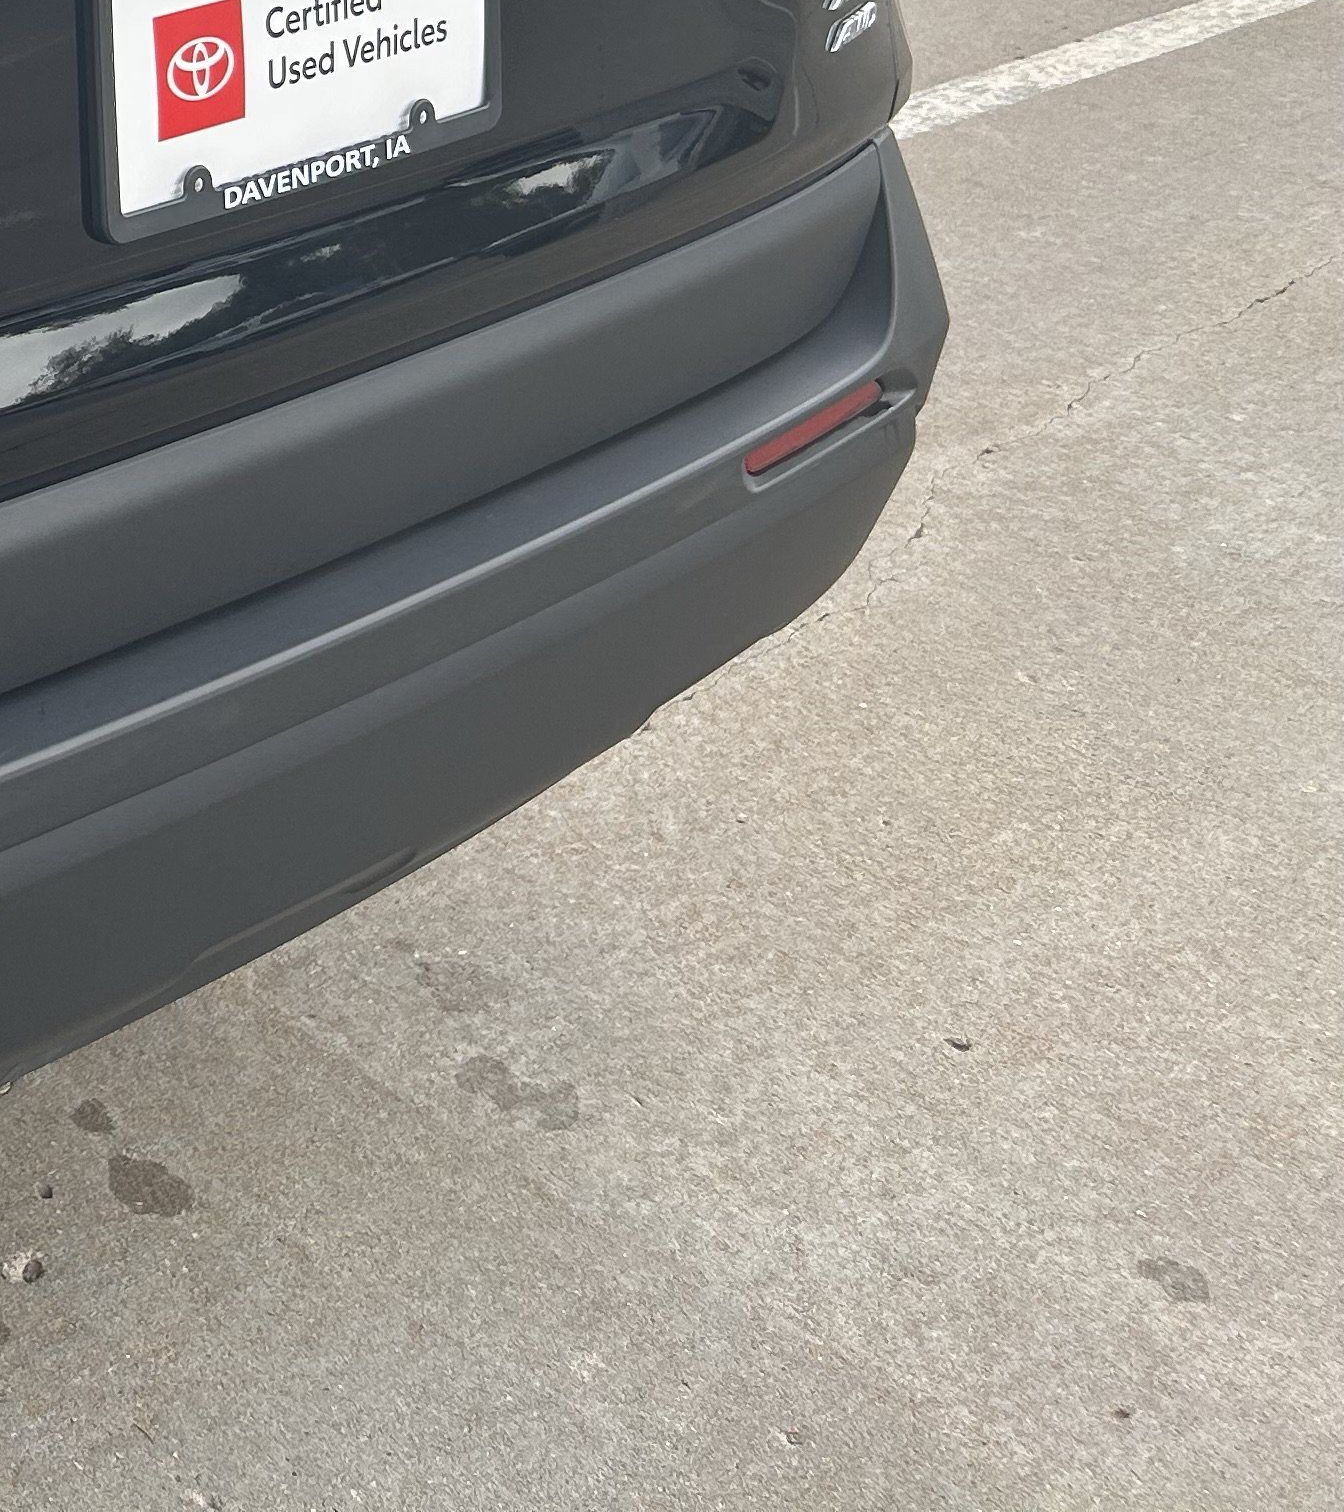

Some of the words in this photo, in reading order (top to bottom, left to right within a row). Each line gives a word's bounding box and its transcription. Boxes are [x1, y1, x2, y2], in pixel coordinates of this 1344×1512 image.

[267, 41, 336, 90] Used
[343, 18, 448, 67] Vehicles
[223, 145, 381, 211] DAVENPORT,
[385, 134, 411, 160] IA
